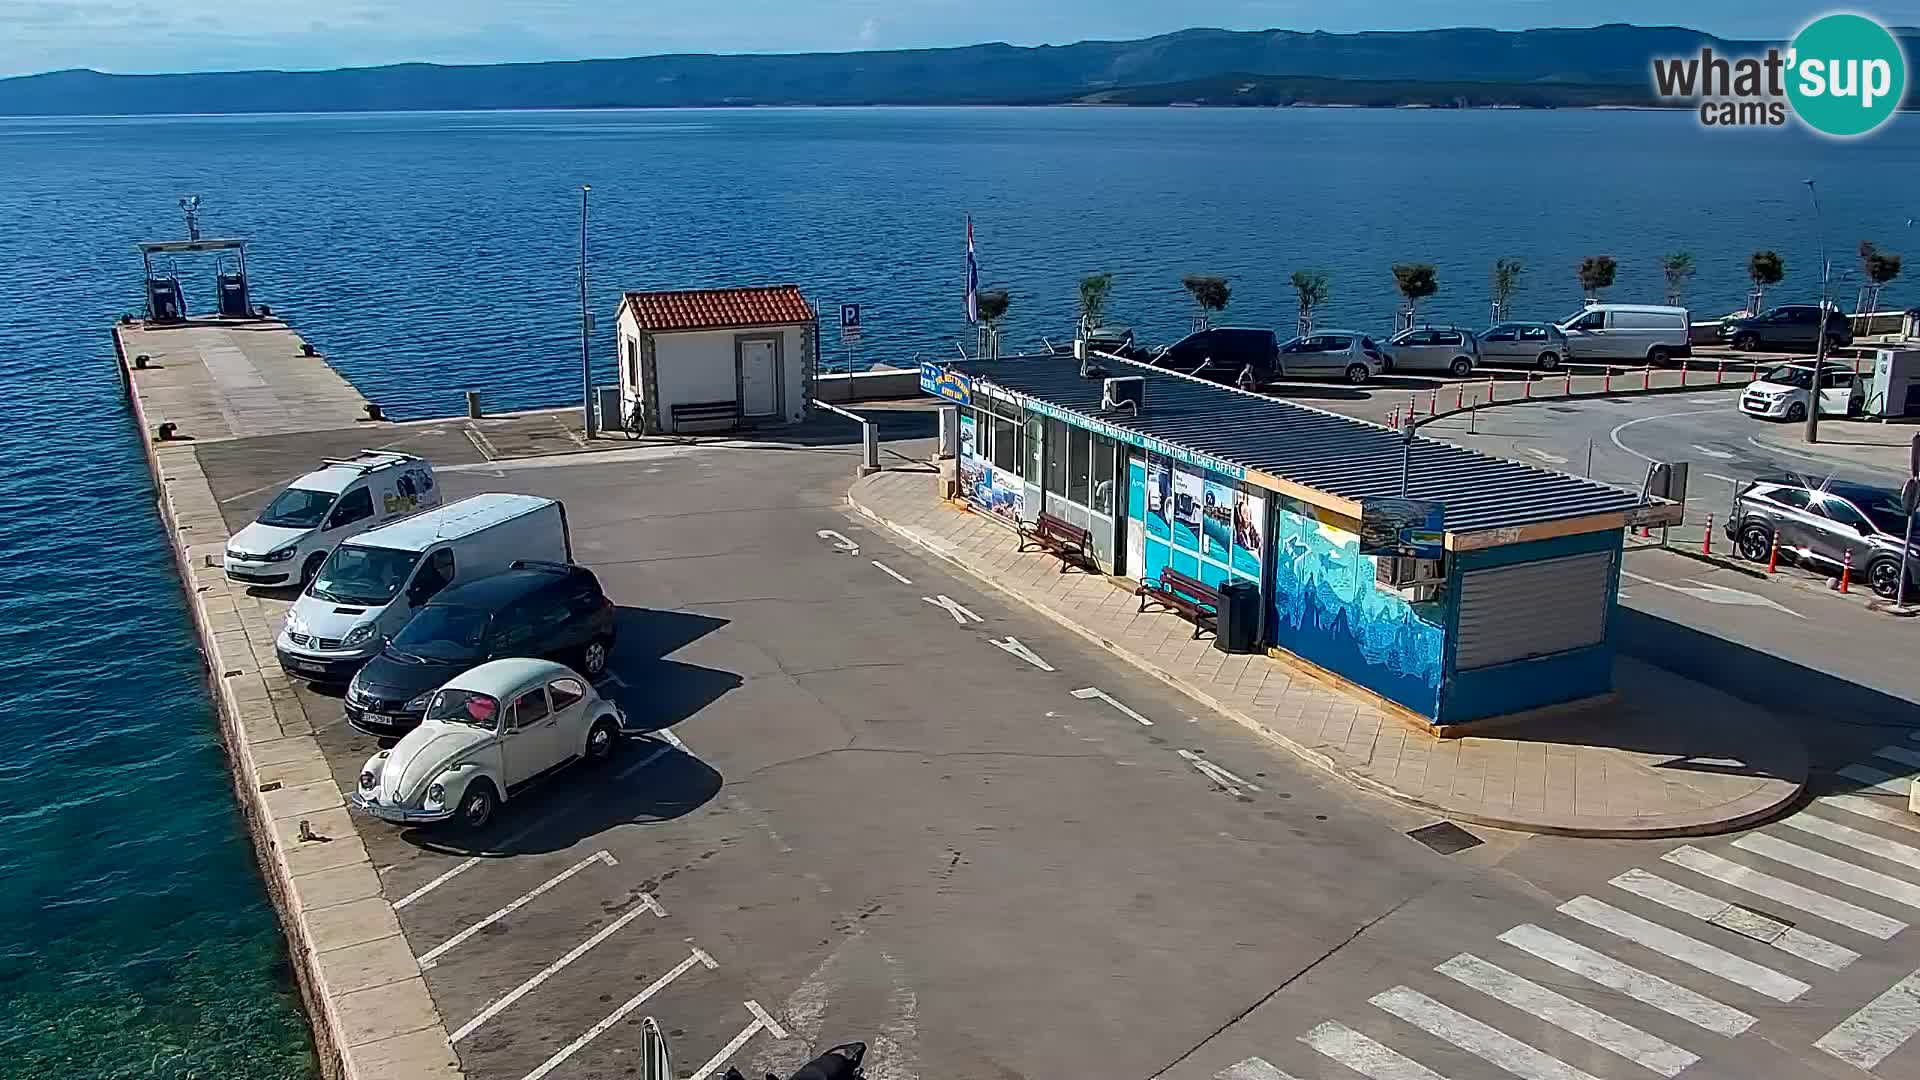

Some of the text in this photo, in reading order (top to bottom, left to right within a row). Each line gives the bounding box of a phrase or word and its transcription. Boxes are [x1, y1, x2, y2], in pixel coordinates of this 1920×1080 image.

[1105, 424, 1134, 444] POSTAJA
[1158, 442, 1188, 461] STATION
[1189, 450, 1214, 469] TICKET
[1215, 461, 1241, 478] OFFICE
